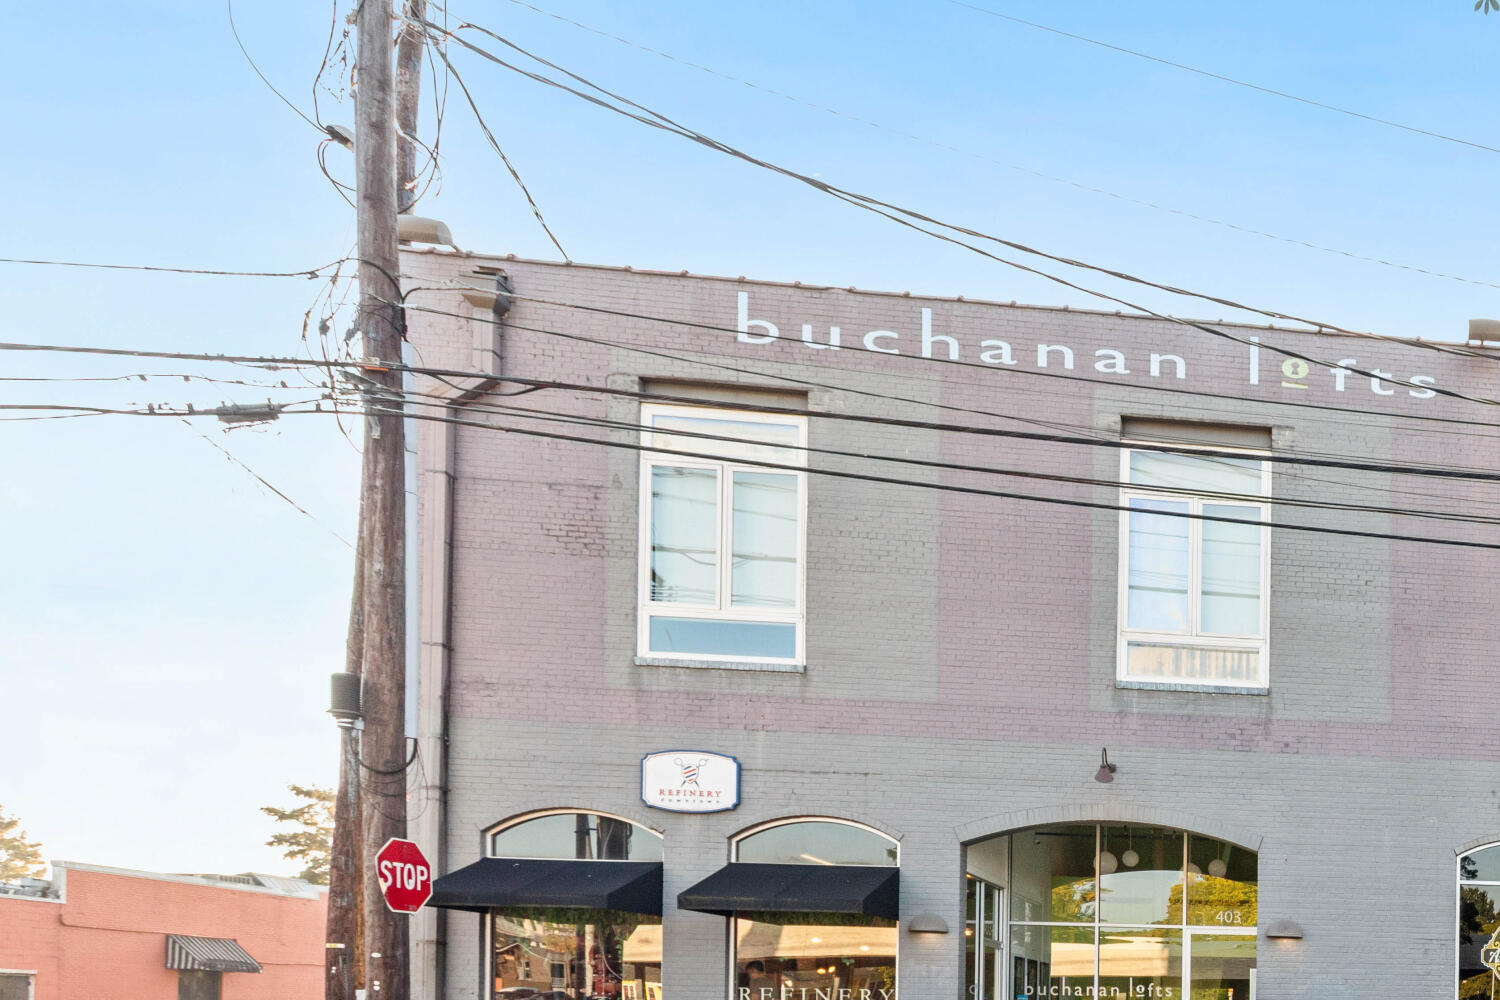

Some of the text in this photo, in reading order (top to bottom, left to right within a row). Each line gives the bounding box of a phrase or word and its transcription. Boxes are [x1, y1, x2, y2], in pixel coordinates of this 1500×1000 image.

[737, 291, 1436, 399] buchanan lofts
[658, 788, 721, 798] REFINERY
[380, 860, 429, 891] STOP
[1215, 910, 1242, 924] 403
[1024, 975, 1173, 998] buchanan lofts
